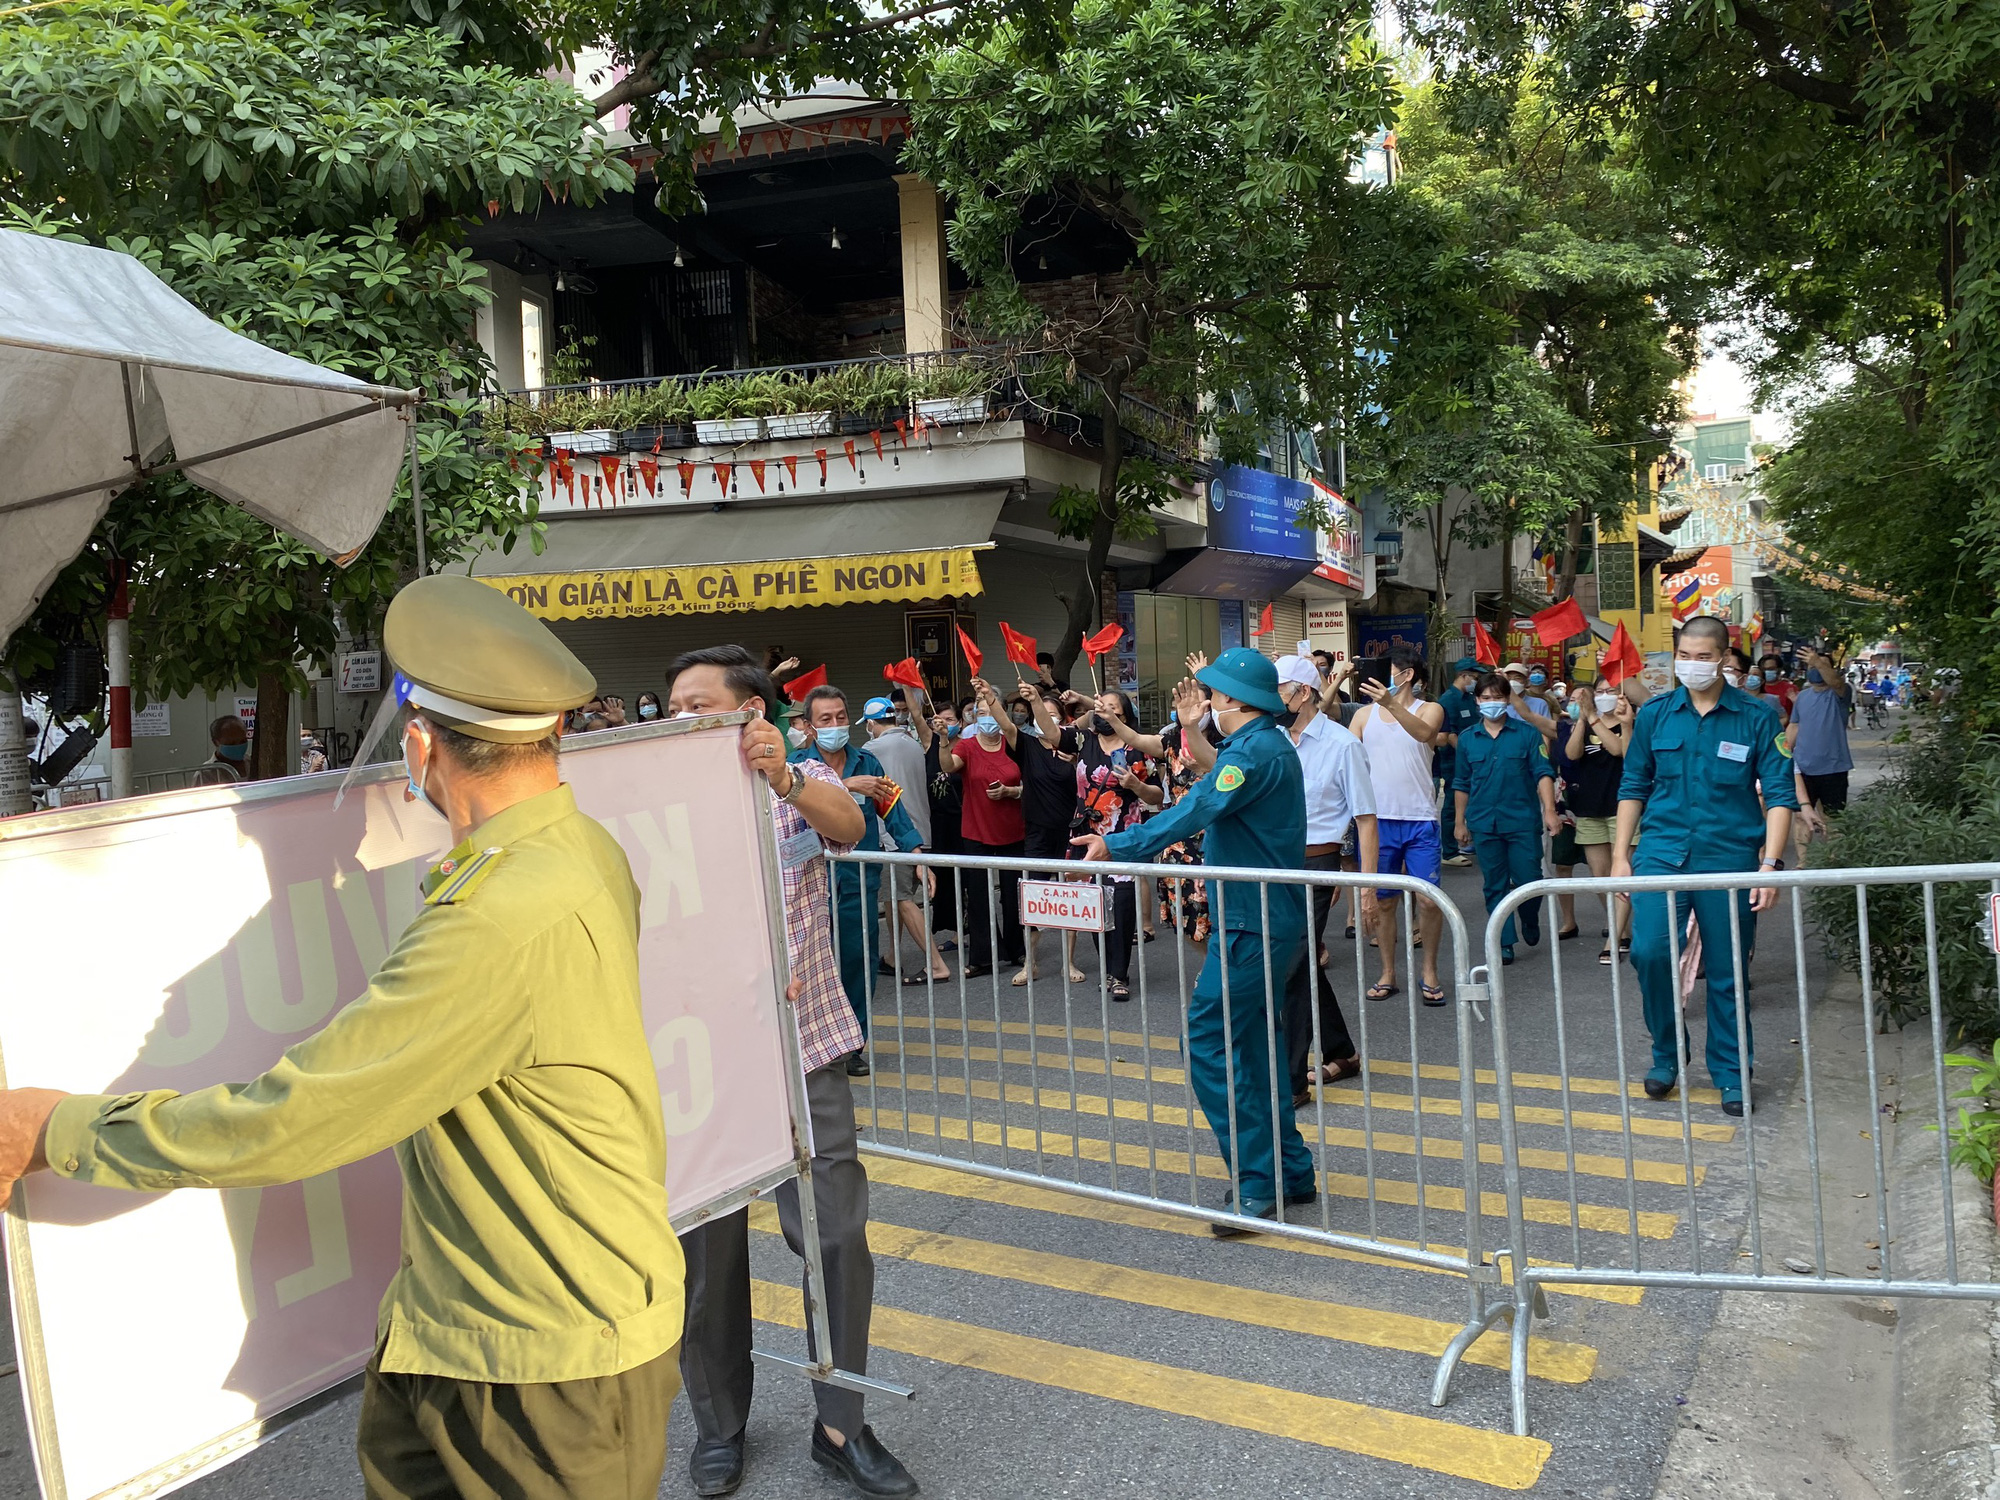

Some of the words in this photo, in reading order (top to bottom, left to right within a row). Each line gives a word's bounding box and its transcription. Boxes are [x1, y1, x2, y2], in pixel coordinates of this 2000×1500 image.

[499, 583, 548, 609] ƠN
[558, 573, 633, 607] GIẢN
[644, 572, 684, 601] LÀ
[697, 569, 740, 600] CÀ
[753, 563, 818, 597] PHÊ
[834, 562, 926, 592] NGON
[940, 560, 950, 584] !
[586, 606, 604, 616] Số
[610, 606, 618, 614] 1
[625, 603, 653, 614] Ngõ
[656, 603, 677, 612] 24
[682, 601, 711, 612] Kim
[716, 599, 756, 611] Đồng
[1043, 888, 1079, 899] C.A.H.N
[1027, 897, 1068, 917] DỪNG
[1071, 904, 1096, 922] LẠI
